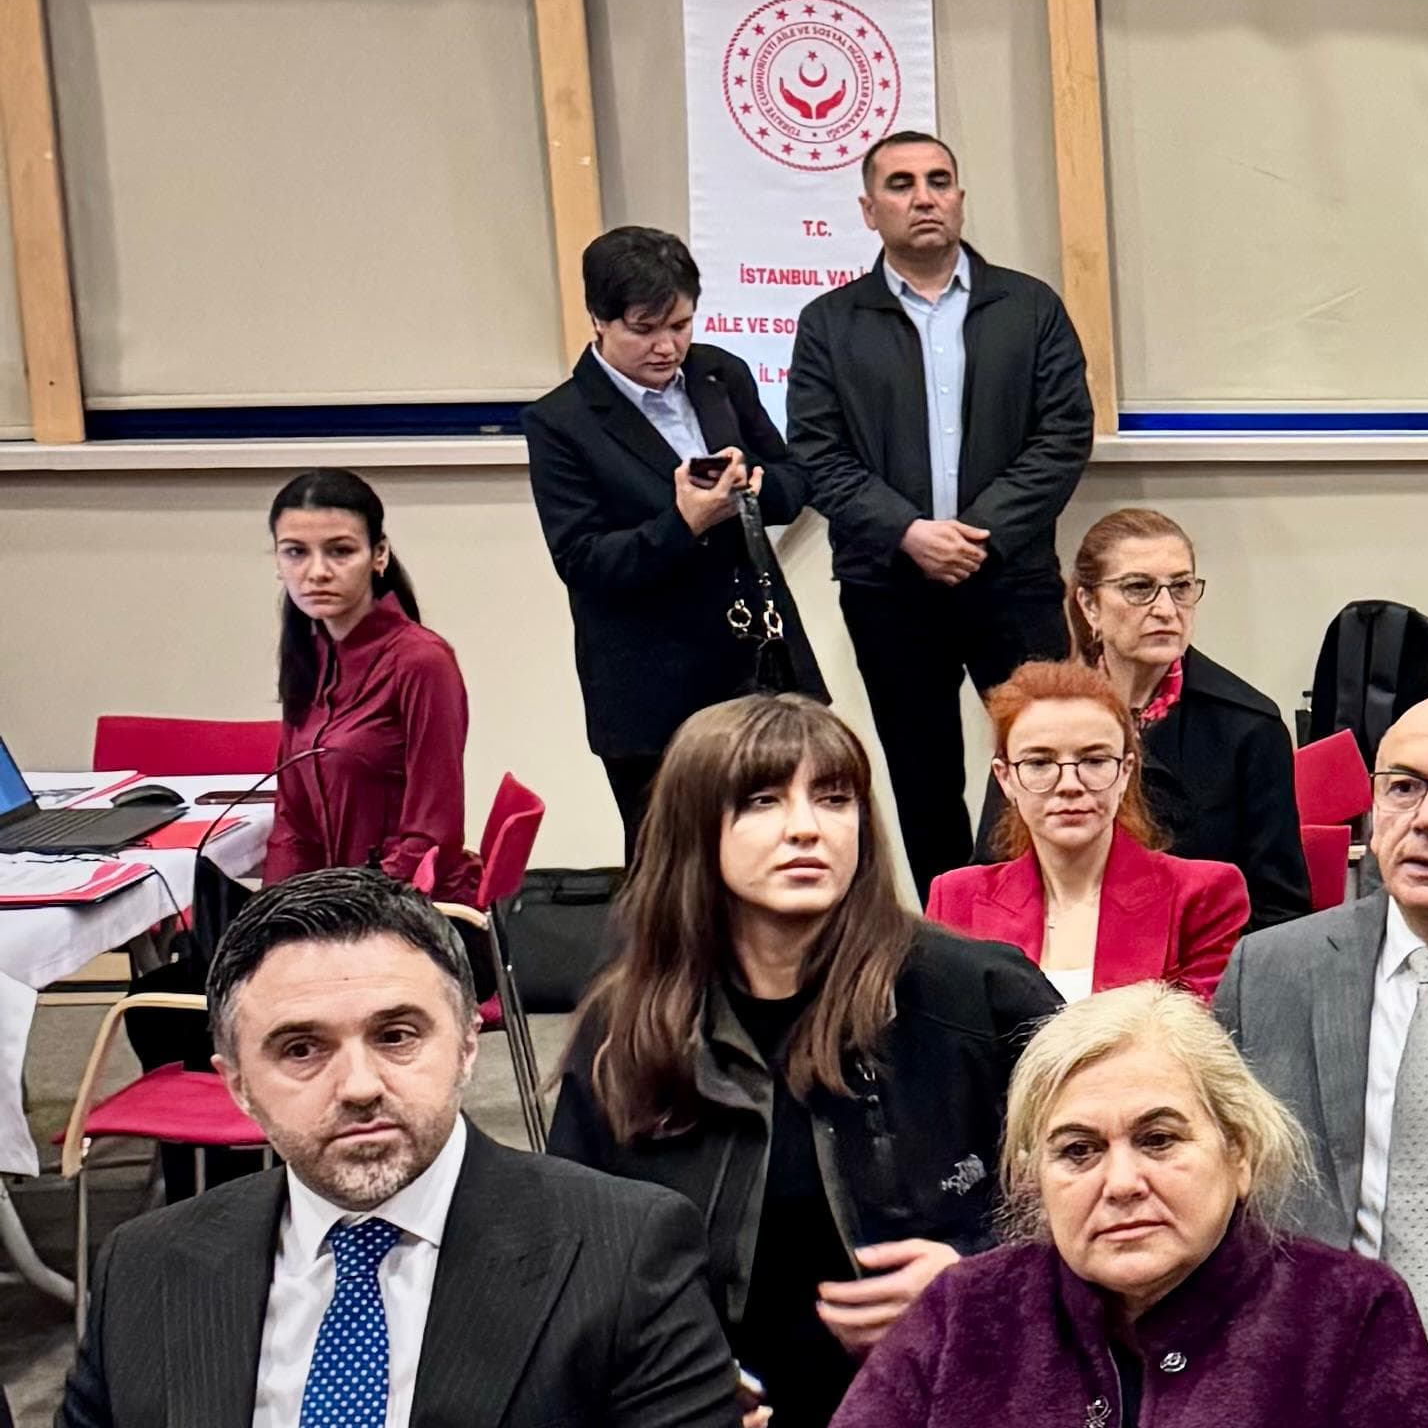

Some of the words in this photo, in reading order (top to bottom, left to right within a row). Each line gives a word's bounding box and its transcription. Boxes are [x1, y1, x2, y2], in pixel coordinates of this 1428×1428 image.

[796, 25, 809, 35] VE
[802, 220, 832, 237] T.C.
[740, 263, 824, 286] İSTANBUL
[704, 313, 743, 333] AİLE
[748, 318, 769, 333] VE
[760, 363, 774, 383] İL
